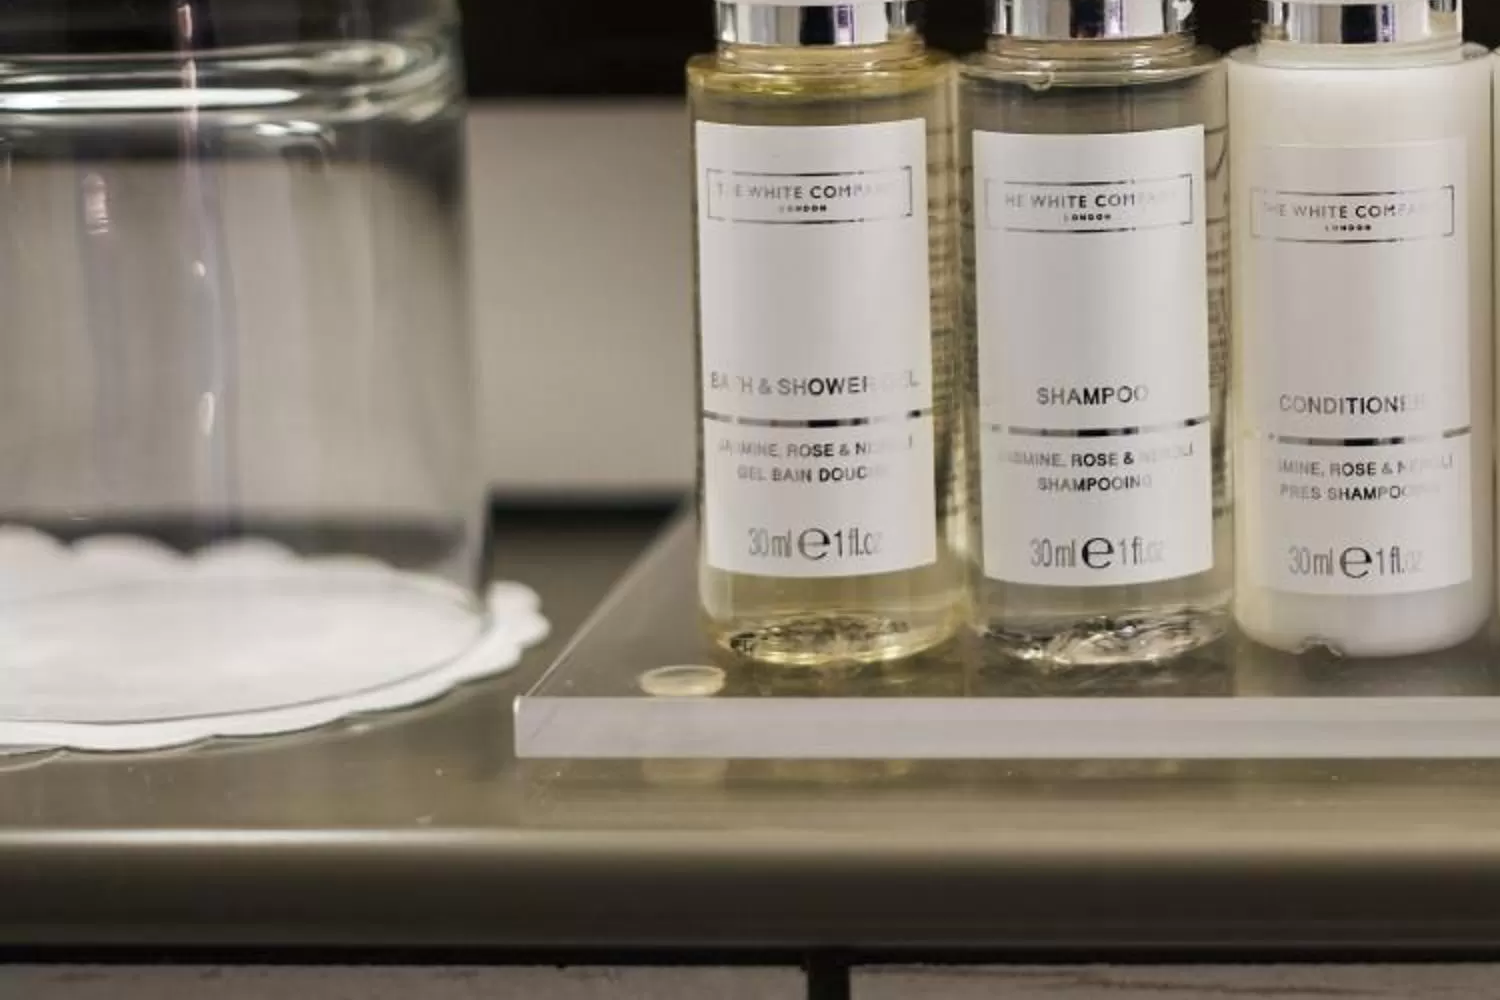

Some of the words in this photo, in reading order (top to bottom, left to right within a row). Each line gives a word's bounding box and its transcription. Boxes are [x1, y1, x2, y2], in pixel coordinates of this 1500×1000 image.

[749, 184, 803, 199] WHITE
[1032, 194, 1087, 209] WHITE
[1293, 204, 1349, 219] WHITE
[757, 378, 772, 396] &
[1036, 385, 1150, 405] SHAMPOO
[787, 443, 834, 457] ROSE
[838, 443, 850, 457] &
[1071, 452, 1119, 468] ROSE
[1123, 451, 1135, 466] &
[771, 468, 813, 483] BAIN
[1329, 461, 1377, 477] ROSE
[1381, 461, 1394, 476] &
